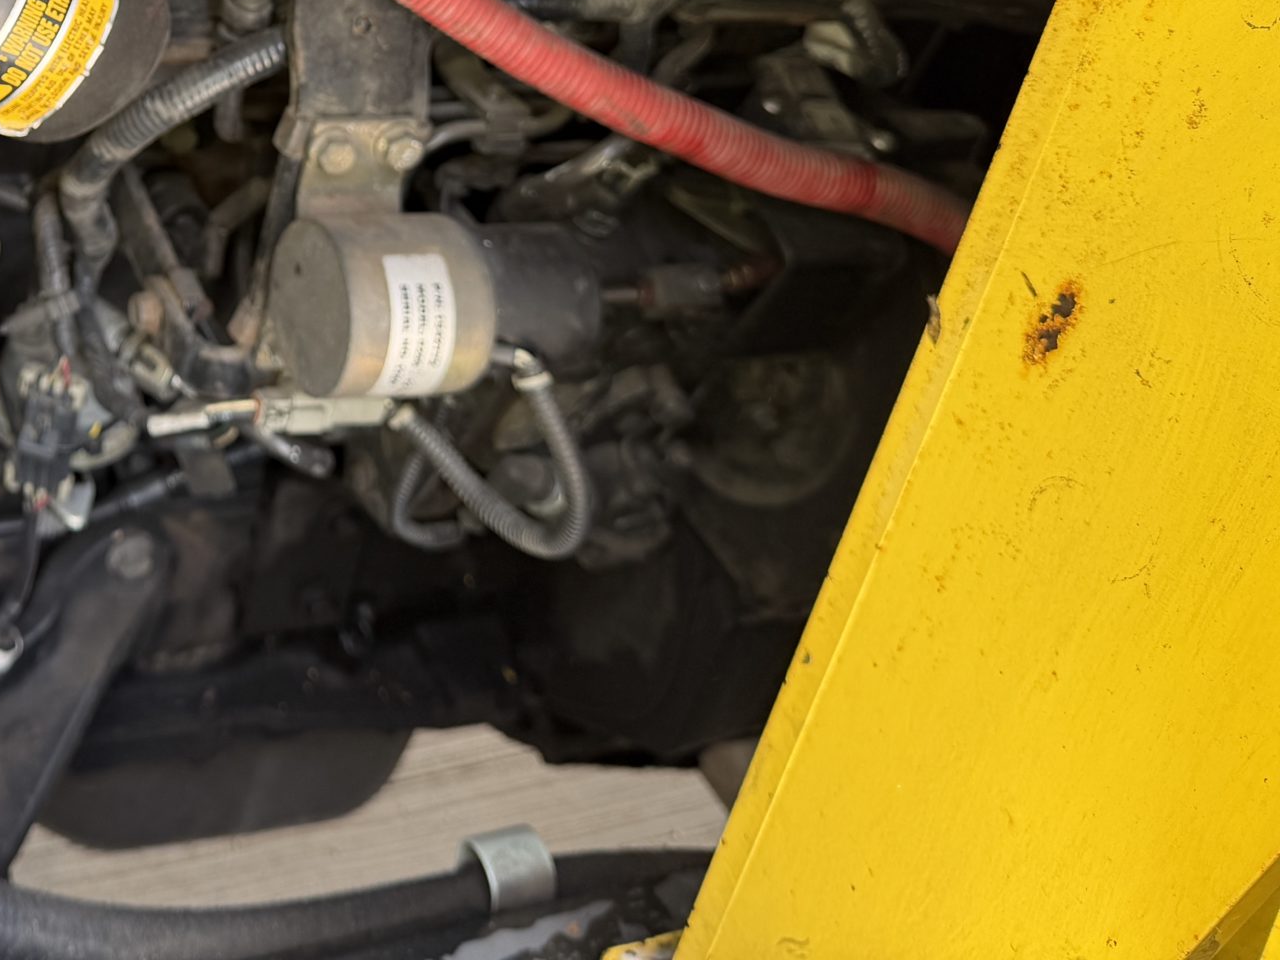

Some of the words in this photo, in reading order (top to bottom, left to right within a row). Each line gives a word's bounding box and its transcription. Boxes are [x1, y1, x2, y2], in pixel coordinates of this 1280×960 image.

[86, 7, 97, 24] MAY
[94, 3, 108, 31] INJURY
[61, 19, 82, 54] ELECTRIC
[1, 66, 28, 87] DO
[15, 42, 45, 71] NOT
[31, 18, 60, 47] USE
